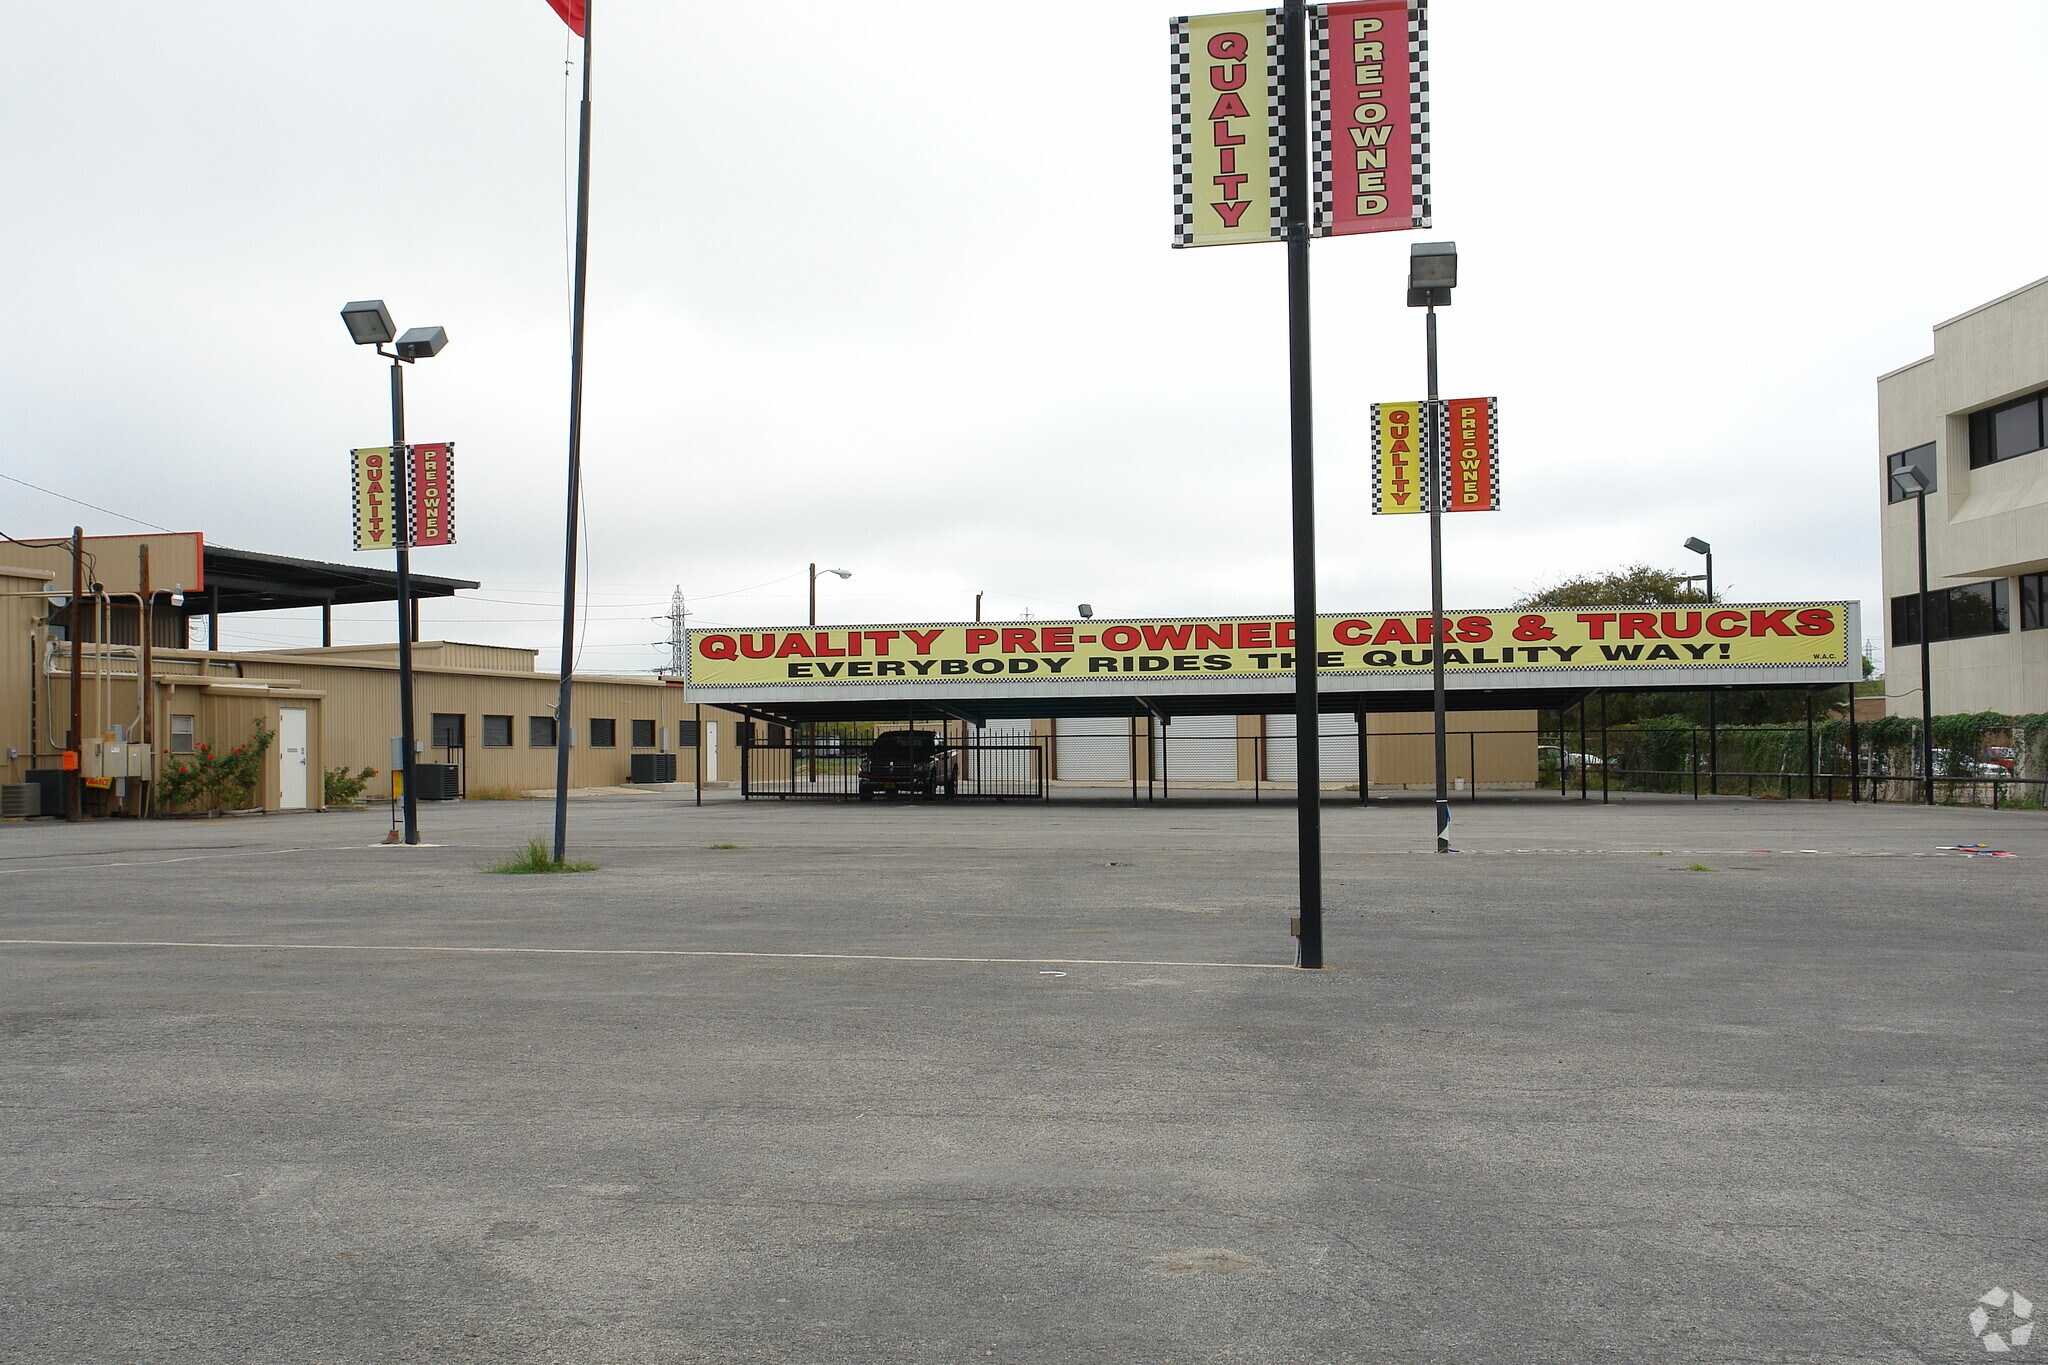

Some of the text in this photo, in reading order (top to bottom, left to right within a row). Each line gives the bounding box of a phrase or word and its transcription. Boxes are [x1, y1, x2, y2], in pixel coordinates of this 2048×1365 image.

[1207, 32, 1252, 228] QUALITY
[1347, 18, 1394, 217] PRE-OWNED
[365, 455, 385, 542] QUALITY
[423, 450, 441, 538] PRE-OWNED
[1389, 410, 1411, 505] QUALITY
[1459, 407, 1481, 504] PRE-OWNED
[699, 608, 1835, 662] QUALITY PRE-OWNED CARS & TRUCKS
[787, 643, 1731, 678] EVERYBODY RIDES THE QUALITY WAY!
